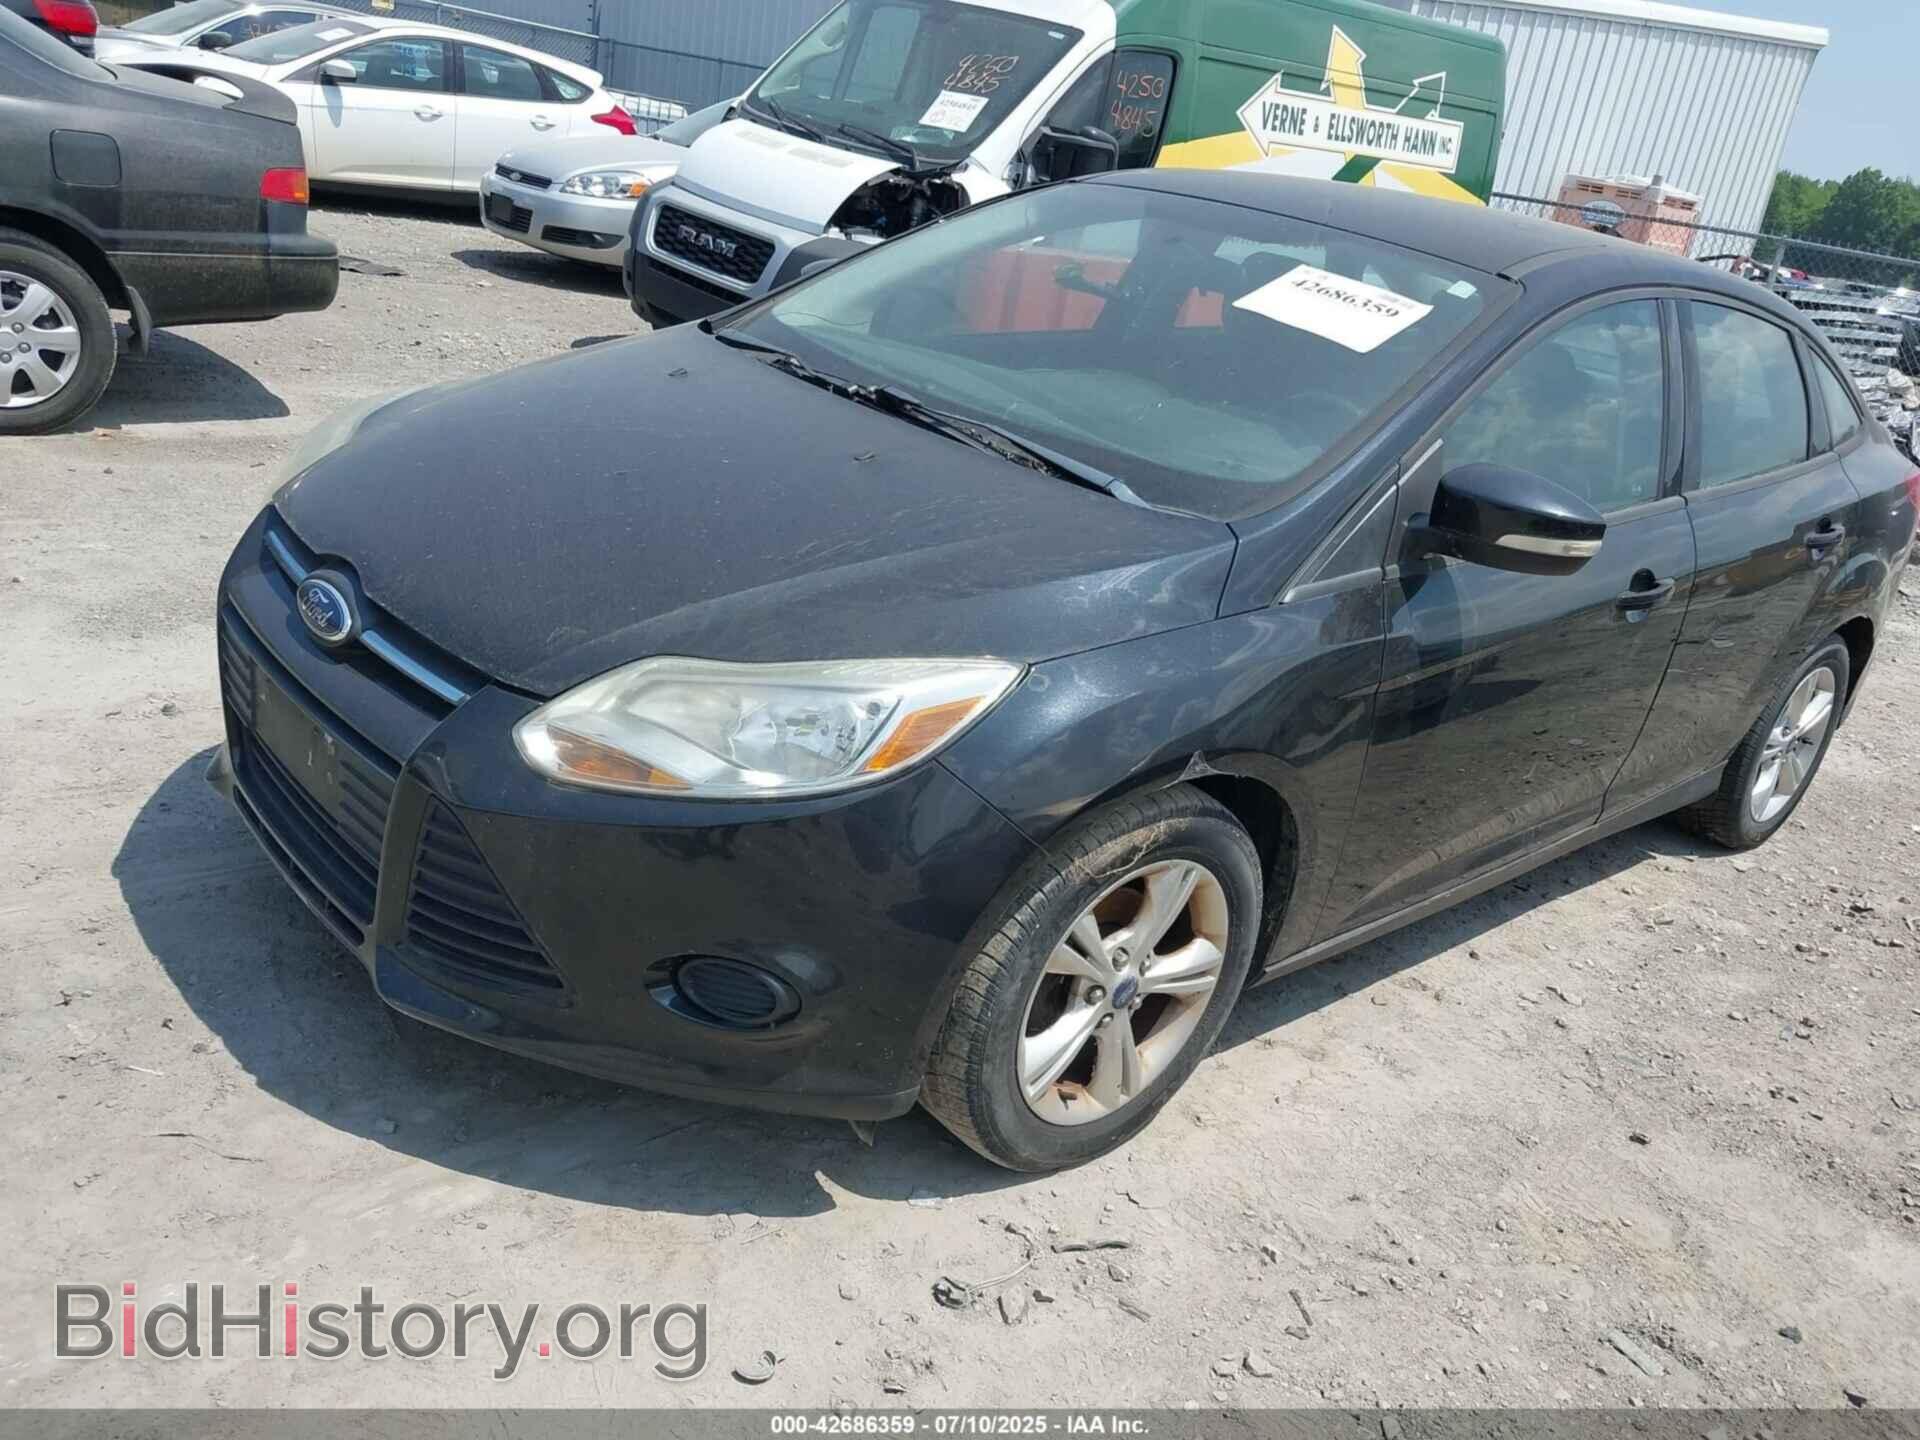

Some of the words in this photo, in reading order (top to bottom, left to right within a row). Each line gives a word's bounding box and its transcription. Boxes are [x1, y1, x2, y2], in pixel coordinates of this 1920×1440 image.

[944, 71, 1008, 93] 4845
[1116, 71, 1165, 98] 4250
[1111, 101, 1160, 136] 4845
[1262, 101, 1307, 136] VERNE
[1313, 114, 1320, 133] &
[1327, 112, 1400, 151] ELLSWORTH
[1402, 125, 1439, 156] HANN
[679, 224, 737, 258] RAM
[1292, 279, 1400, 318] 42686359
[302, 587, 334, 629] Ford
